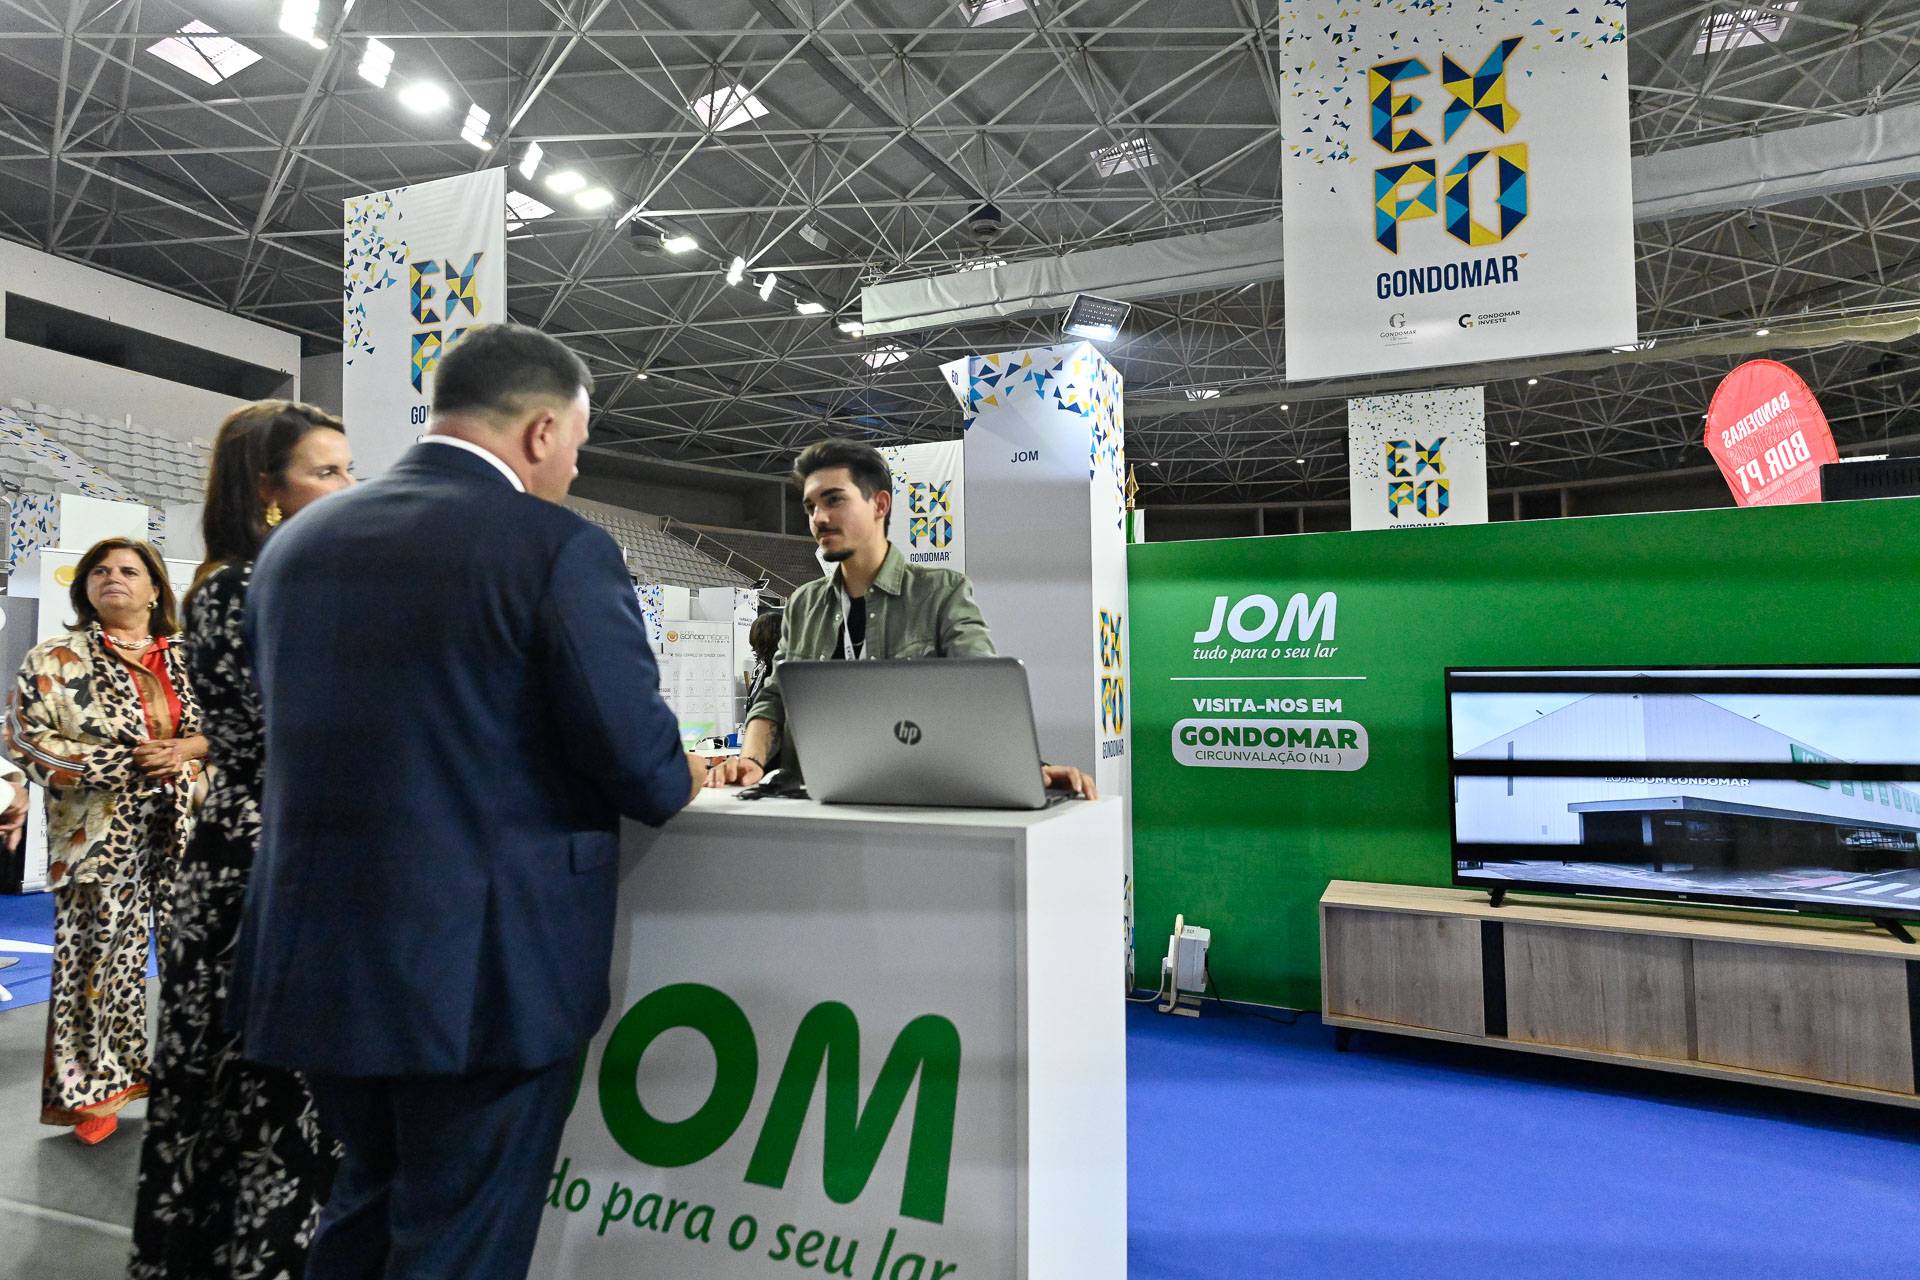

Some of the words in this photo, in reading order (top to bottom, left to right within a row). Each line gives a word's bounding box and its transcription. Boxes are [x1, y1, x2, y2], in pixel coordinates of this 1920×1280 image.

[1376, 254, 1520, 300] GONDOMAR
[1477, 310, 1521, 320] GONDOMAR
[1477, 318, 1507, 326] INVESTE
[1010, 450, 1039, 463] JOM
[910, 551, 950, 563] GONDOMAR
[1193, 591, 1337, 643] JOM
[1193, 645, 1227, 660] tudo
[1229, 647, 1267, 663] para
[1271, 648, 1281, 659] o
[1284, 647, 1311, 659] seu
[1313, 643, 1338, 658] lar
[1192, 698, 1309, 713] VISITA-NOS
[1312, 698, 1343, 713] EM
[899, 720, 919, 745] hp
[1179, 725, 1359, 750] GONDOMAR
[1102, 738, 1125, 760] GONDOMAR
[1195, 750, 1306, 766] CIRCUNVALAÇÃO
[567, 981, 962, 1224] OM
[597, 1181, 716, 1244] para
[727, 1213, 758, 1253] o
[768, 1223, 859, 1280] seu
